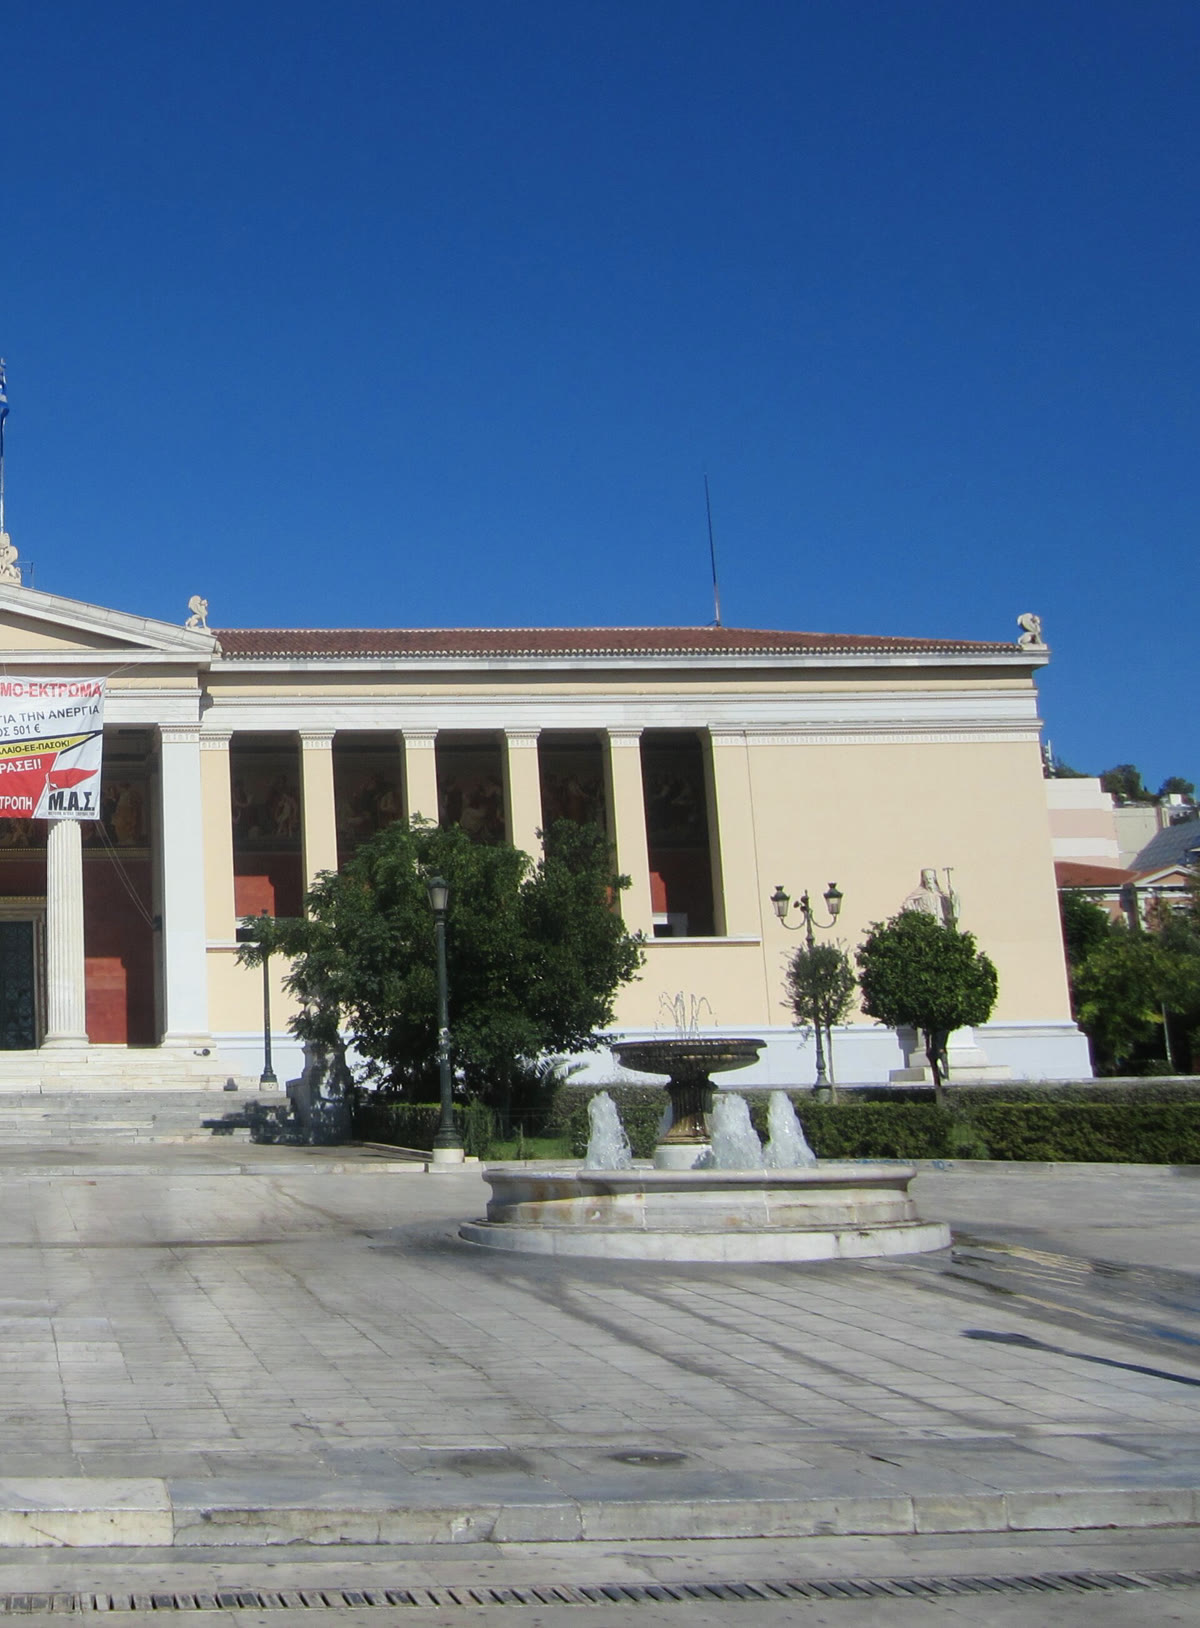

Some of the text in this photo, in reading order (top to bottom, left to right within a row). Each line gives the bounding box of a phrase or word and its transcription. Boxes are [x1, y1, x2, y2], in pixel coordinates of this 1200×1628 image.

[19, 711, 45, 722] ΤΗΝ
[48, 705, 100, 719] ΑΝΕΡΓΙΑ
[13, 725, 30, 736] 501
[34, 723, 41, 733] €
[48, 791, 96, 812] Μ.Α.Σ.
